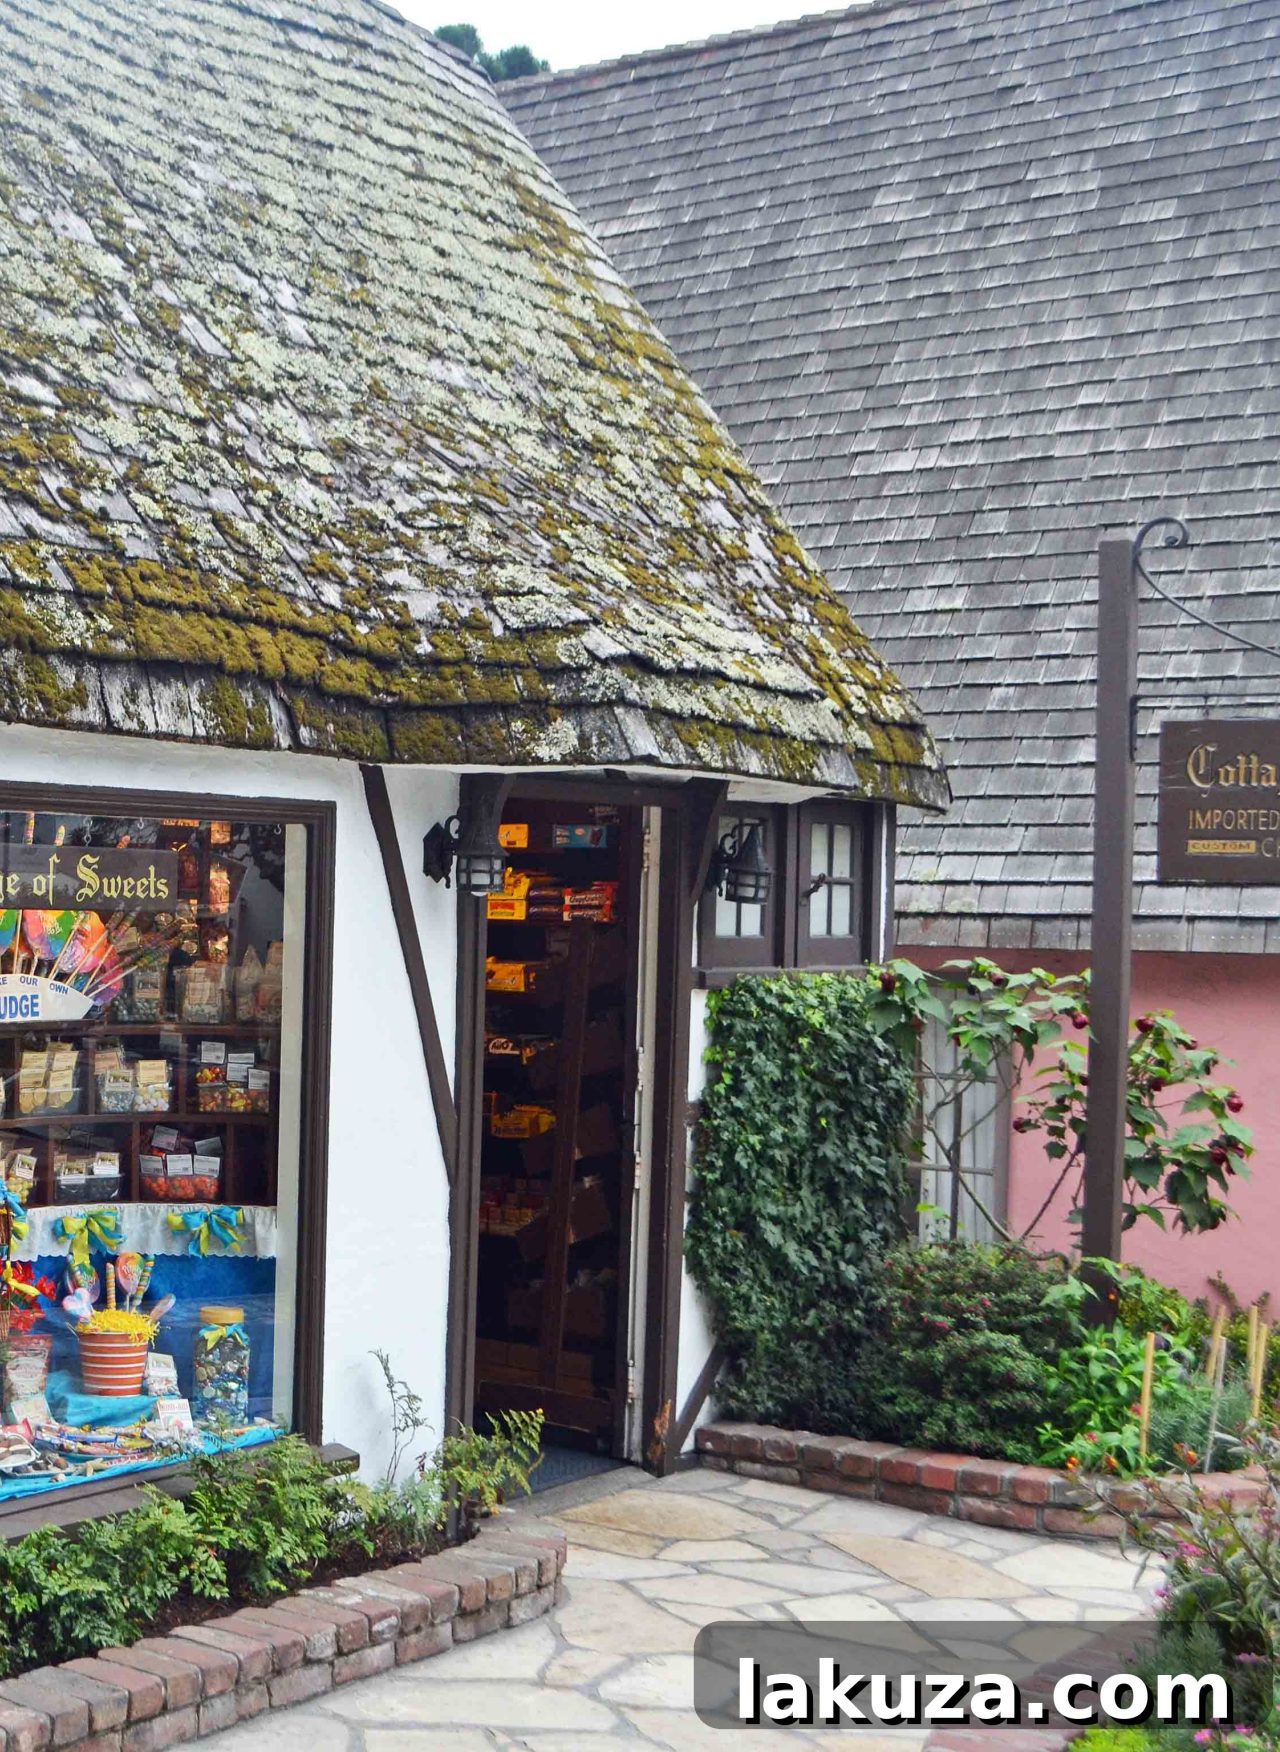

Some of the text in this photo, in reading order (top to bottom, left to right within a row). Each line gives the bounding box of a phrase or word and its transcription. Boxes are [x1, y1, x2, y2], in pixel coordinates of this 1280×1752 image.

[1187, 743, 1280, 798] Cotta
[1188, 809, 1280, 831] IMPORTED
[1191, 837, 1280, 858] CUSTOM C
[33, 853, 60, 906] of
[76, 854, 169, 901] Sweets
[19, 976, 39, 987] OUR
[49, 983, 69, 996] OWN
